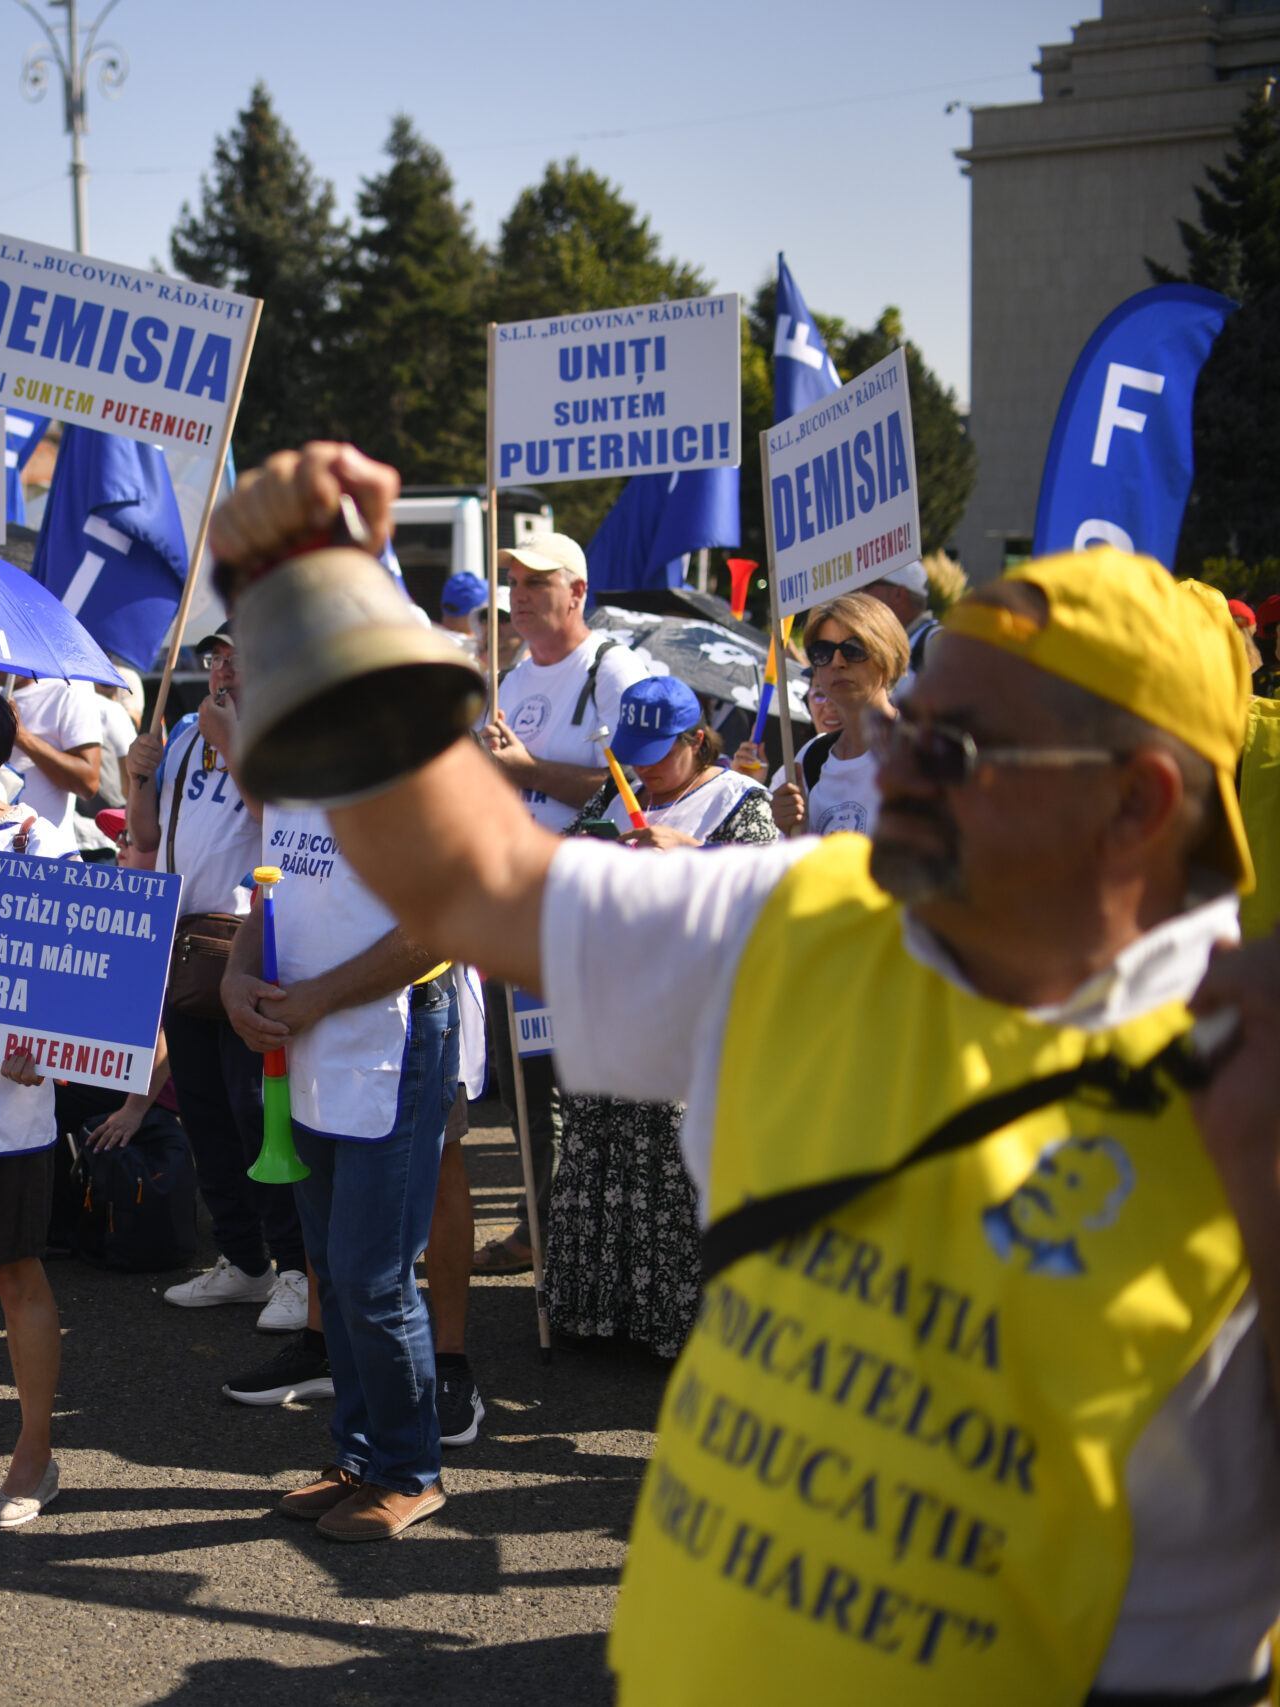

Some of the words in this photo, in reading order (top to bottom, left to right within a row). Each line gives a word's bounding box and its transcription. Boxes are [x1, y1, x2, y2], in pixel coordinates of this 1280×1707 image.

[159, 285, 244, 321] RĂDĂUȚI
[499, 326, 536, 342] S.L.I.
[648, 299, 725, 324] RĂDĂUȚI
[559, 335, 666, 385] UNIȚI
[13, 376, 95, 416] SUNTEM
[101, 399, 213, 446] PUTERNICI!
[554, 391, 666, 427] SUNTEM
[769, 434, 794, 456] S.L.I.
[854, 365, 899, 409] RĂDĂUȚI
[500, 421, 730, 478] PUTERNICI!
[771, 410, 910, 553] DEMISIA
[780, 571, 809, 606] UNIȚI
[811, 550, 853, 584] SUNTEM
[856, 520, 912, 573] PUTERNICI!
[620, 703, 661, 729] FSLI
[63, 865, 167, 902] RĂDĂUȚI
[65, 902, 157, 943] ȘCOALA,
[39, 943, 110, 979] MÂINE
[4, 1033, 133, 1081] PUTERNICI!
[700, 1395, 1007, 1577] EDUCAȚIE
